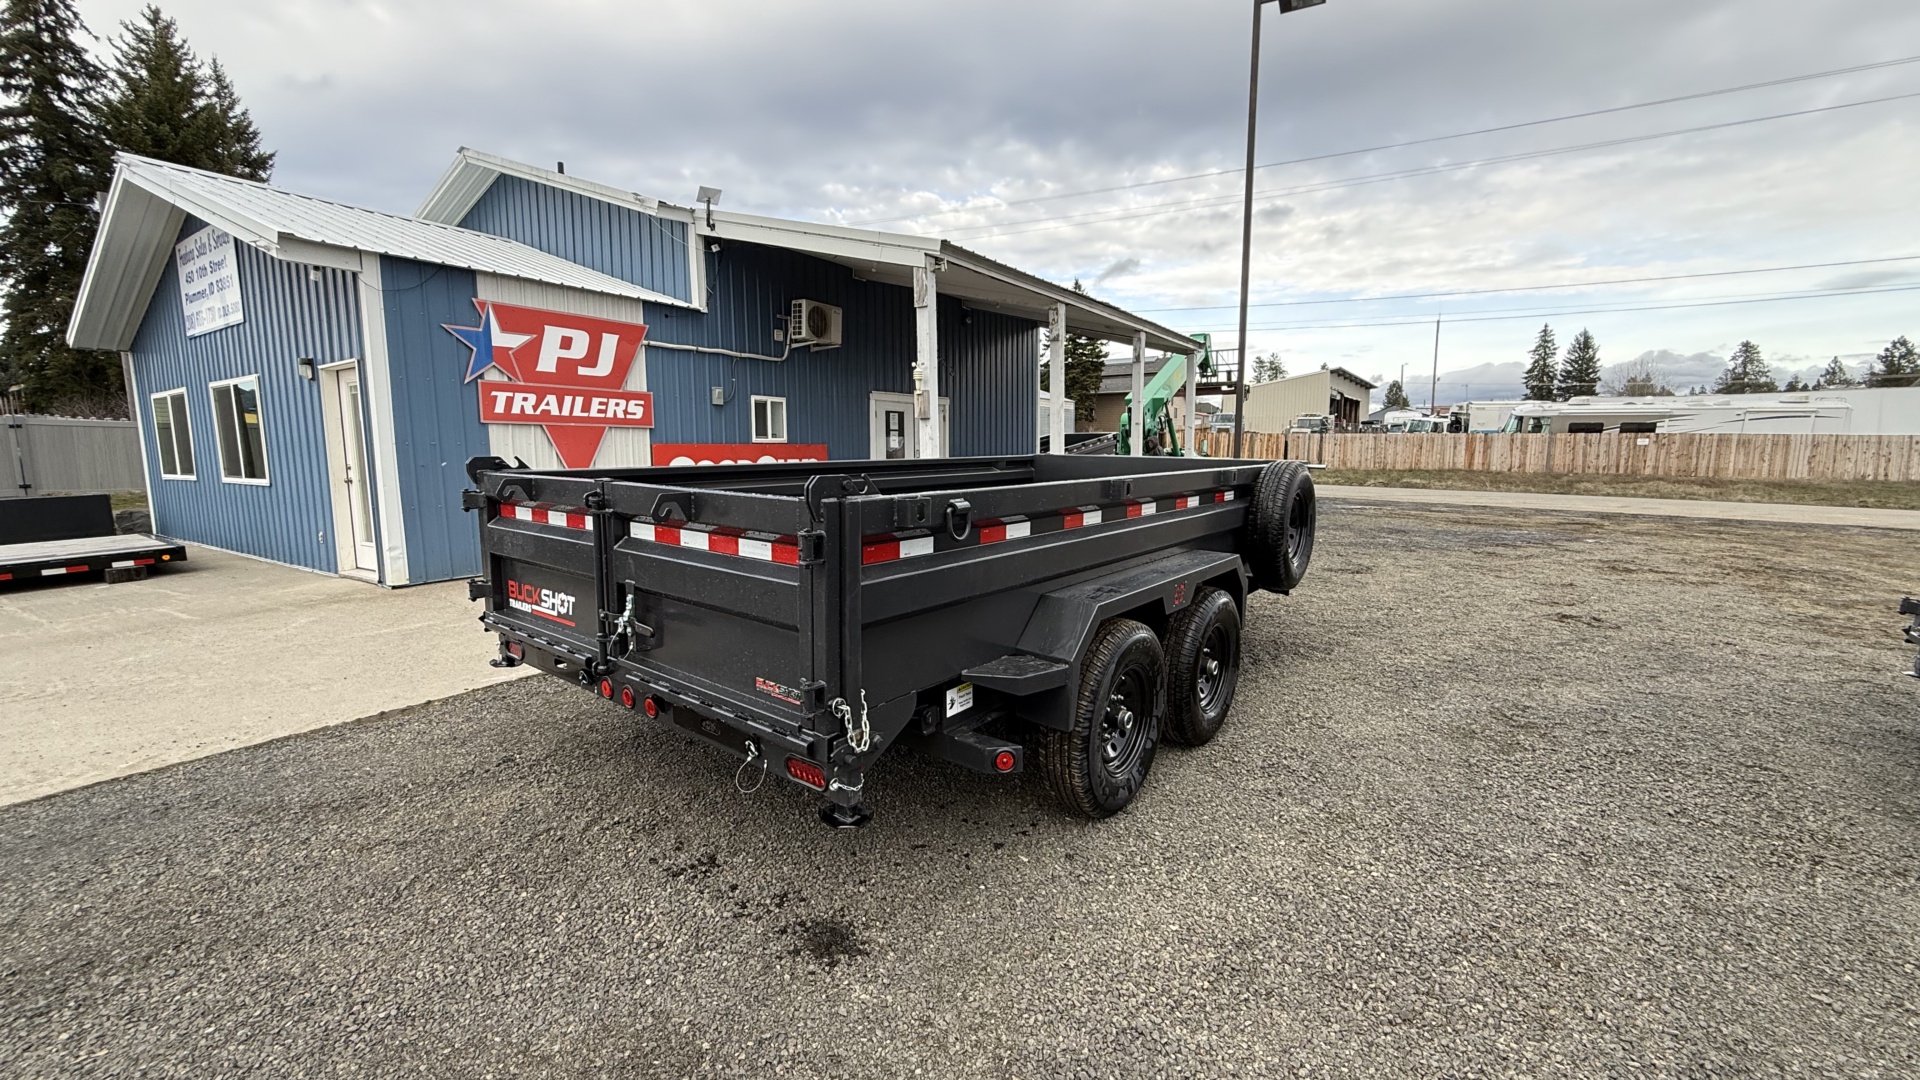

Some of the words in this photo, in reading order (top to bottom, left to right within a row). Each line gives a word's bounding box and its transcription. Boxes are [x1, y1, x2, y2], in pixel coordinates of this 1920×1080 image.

[185, 270, 195, 284] 450
[195, 263, 208, 281] 10th
[209, 254, 228, 274] Street
[536, 325, 620, 377] PJ
[490, 391, 645, 420] TRAILERS
[508, 580, 576, 616] BUCKSHOT
